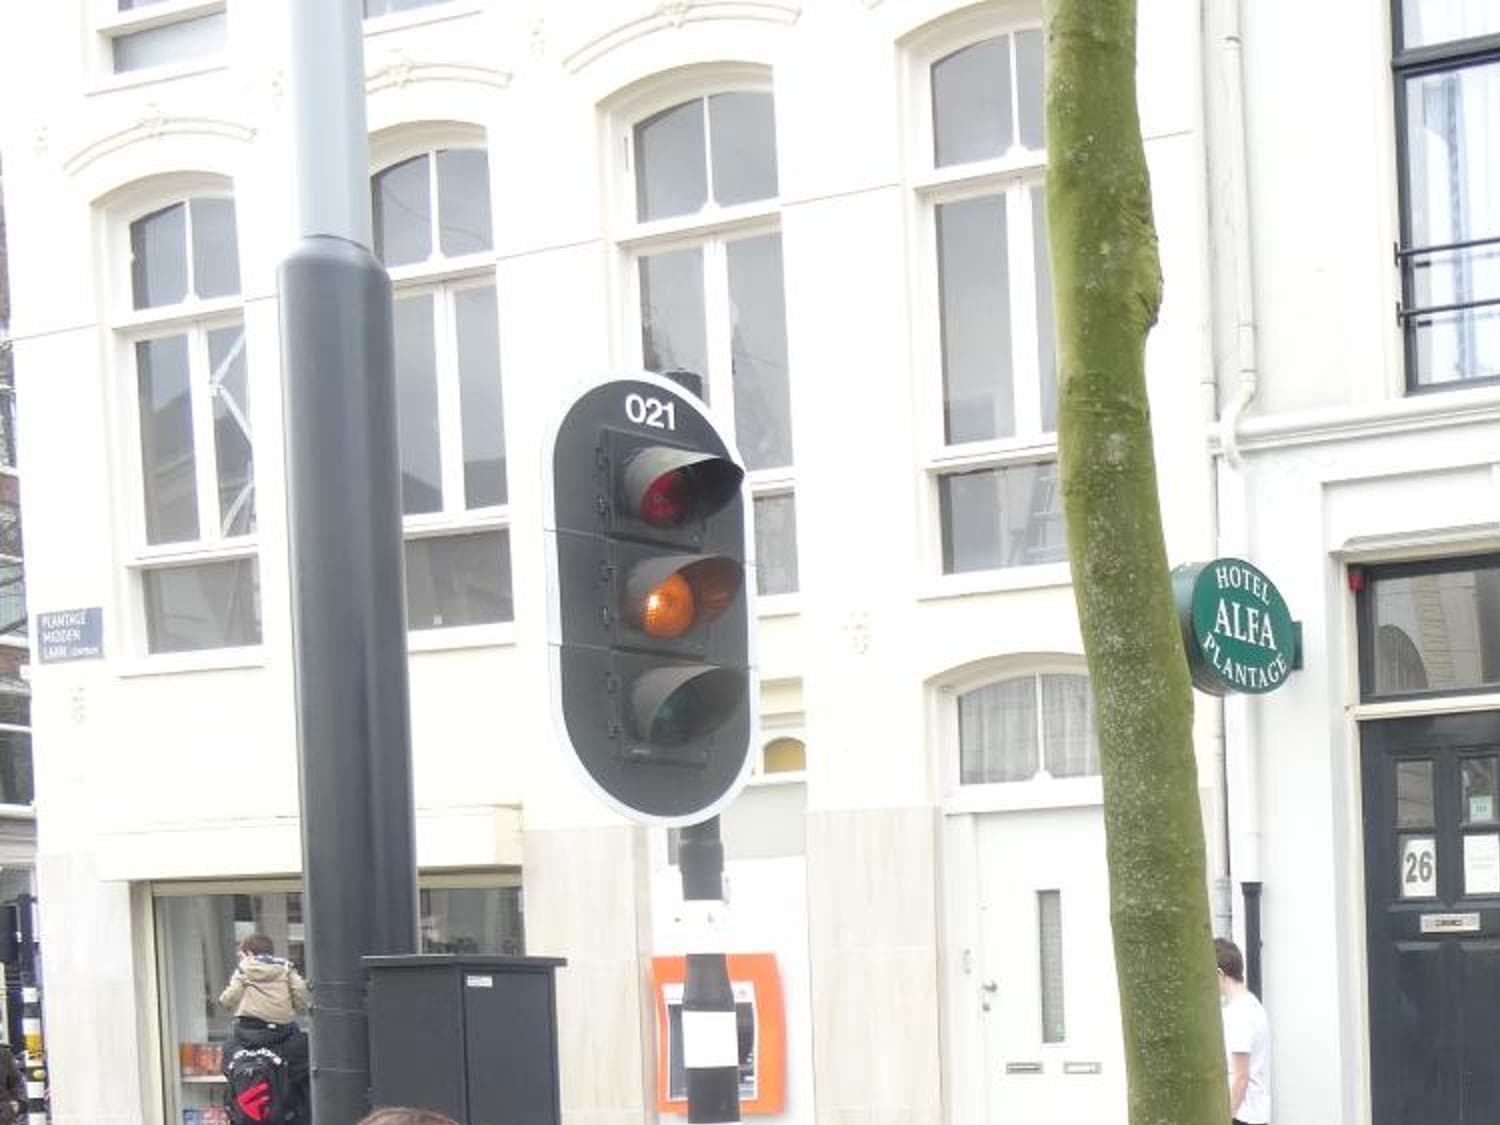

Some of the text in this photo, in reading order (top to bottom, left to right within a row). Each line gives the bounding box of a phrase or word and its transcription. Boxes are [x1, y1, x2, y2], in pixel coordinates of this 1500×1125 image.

[625, 392, 675, 431] 021
[1215, 565, 1271, 606] HOTEL
[1213, 597, 1278, 651] ALFA
[1202, 631, 1288, 689] PLANTAGE
[1405, 851, 1433, 883] 26
